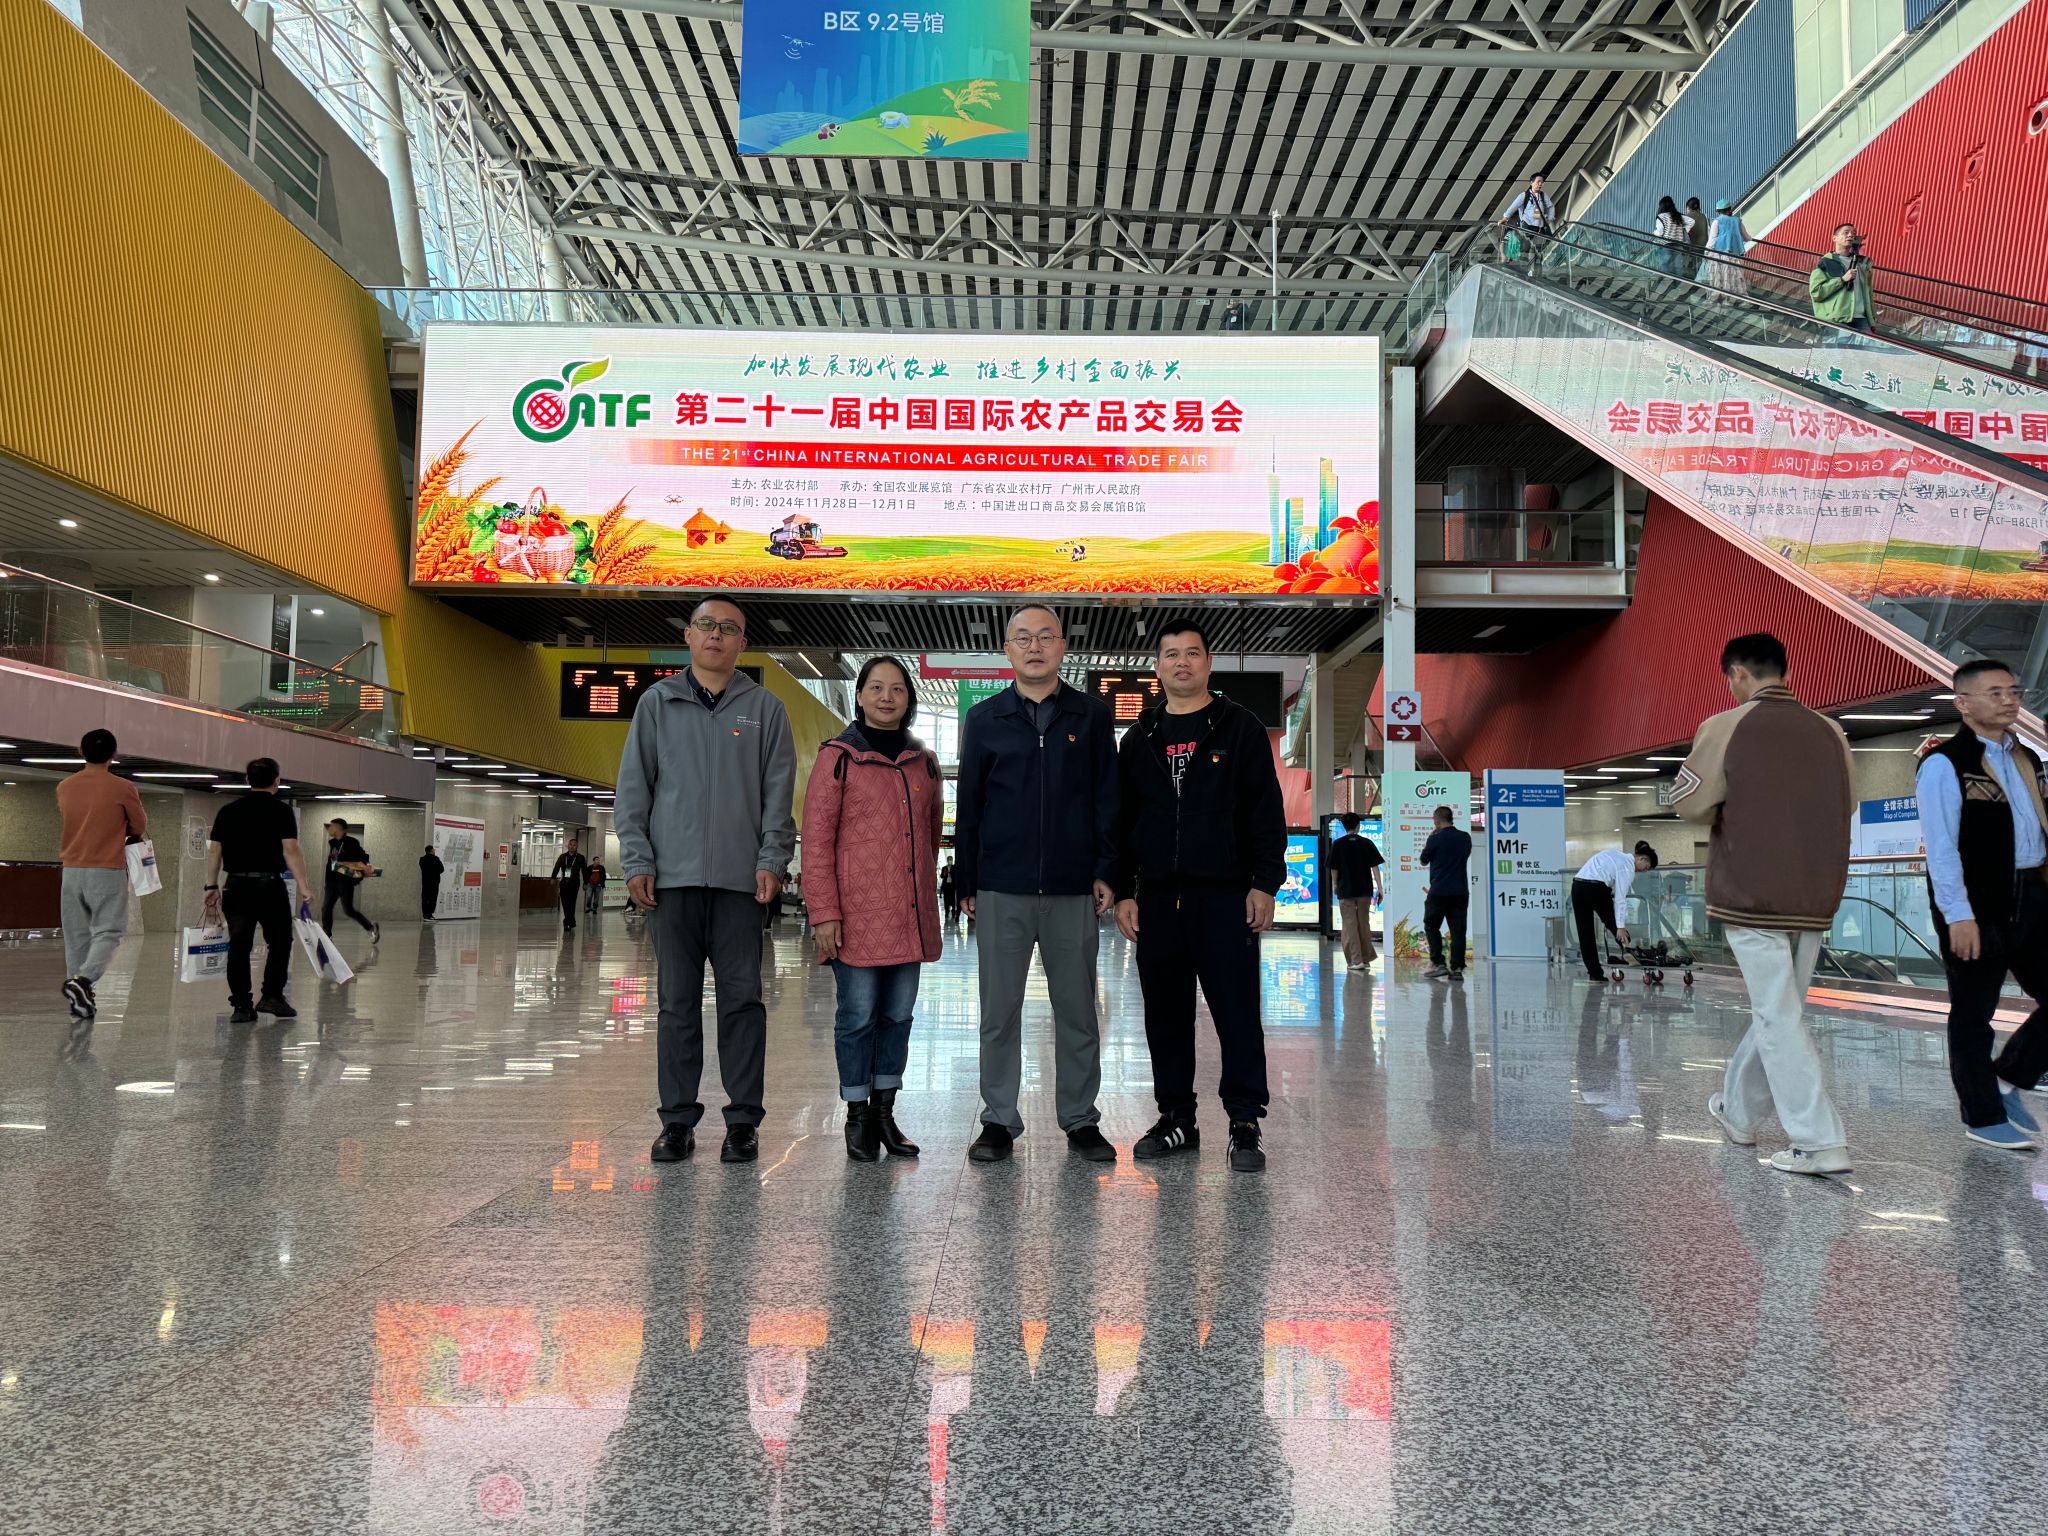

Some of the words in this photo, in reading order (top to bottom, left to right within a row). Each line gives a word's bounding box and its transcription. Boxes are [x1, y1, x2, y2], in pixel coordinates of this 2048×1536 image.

[823, 11, 861, 32] B区
[867, 12, 945, 34] 9.2号馆
[744, 353, 950, 381] 加快发展现代农业
[976, 356, 1182, 384] 推进乡村全面振兴
[676, 393, 1243, 432] 第二十一届中国国际农产品交易会
[682, 447, 715, 460] THE
[722, 448, 750, 461] 21st
[753, 449, 808, 462] CHINA
[815, 450, 955, 465] INTERNATIONAL
[962, 453, 1097, 466] AGRICULTURAL
[1104, 454, 1161, 467] TRADE
[1168, 454, 1208, 467] FAIR
[961, 482, 1053, 495] 广东省农业农村厅
[1061, 483, 1141, 496] 广州市人民政府
[1498, 788, 1517, 803] 2F
[1497, 839, 1528, 854] M1F
[1498, 891, 1517, 907] 1F
[1520, 887, 1537, 896] 展厅
[1540, 888, 1557, 896] Hall
